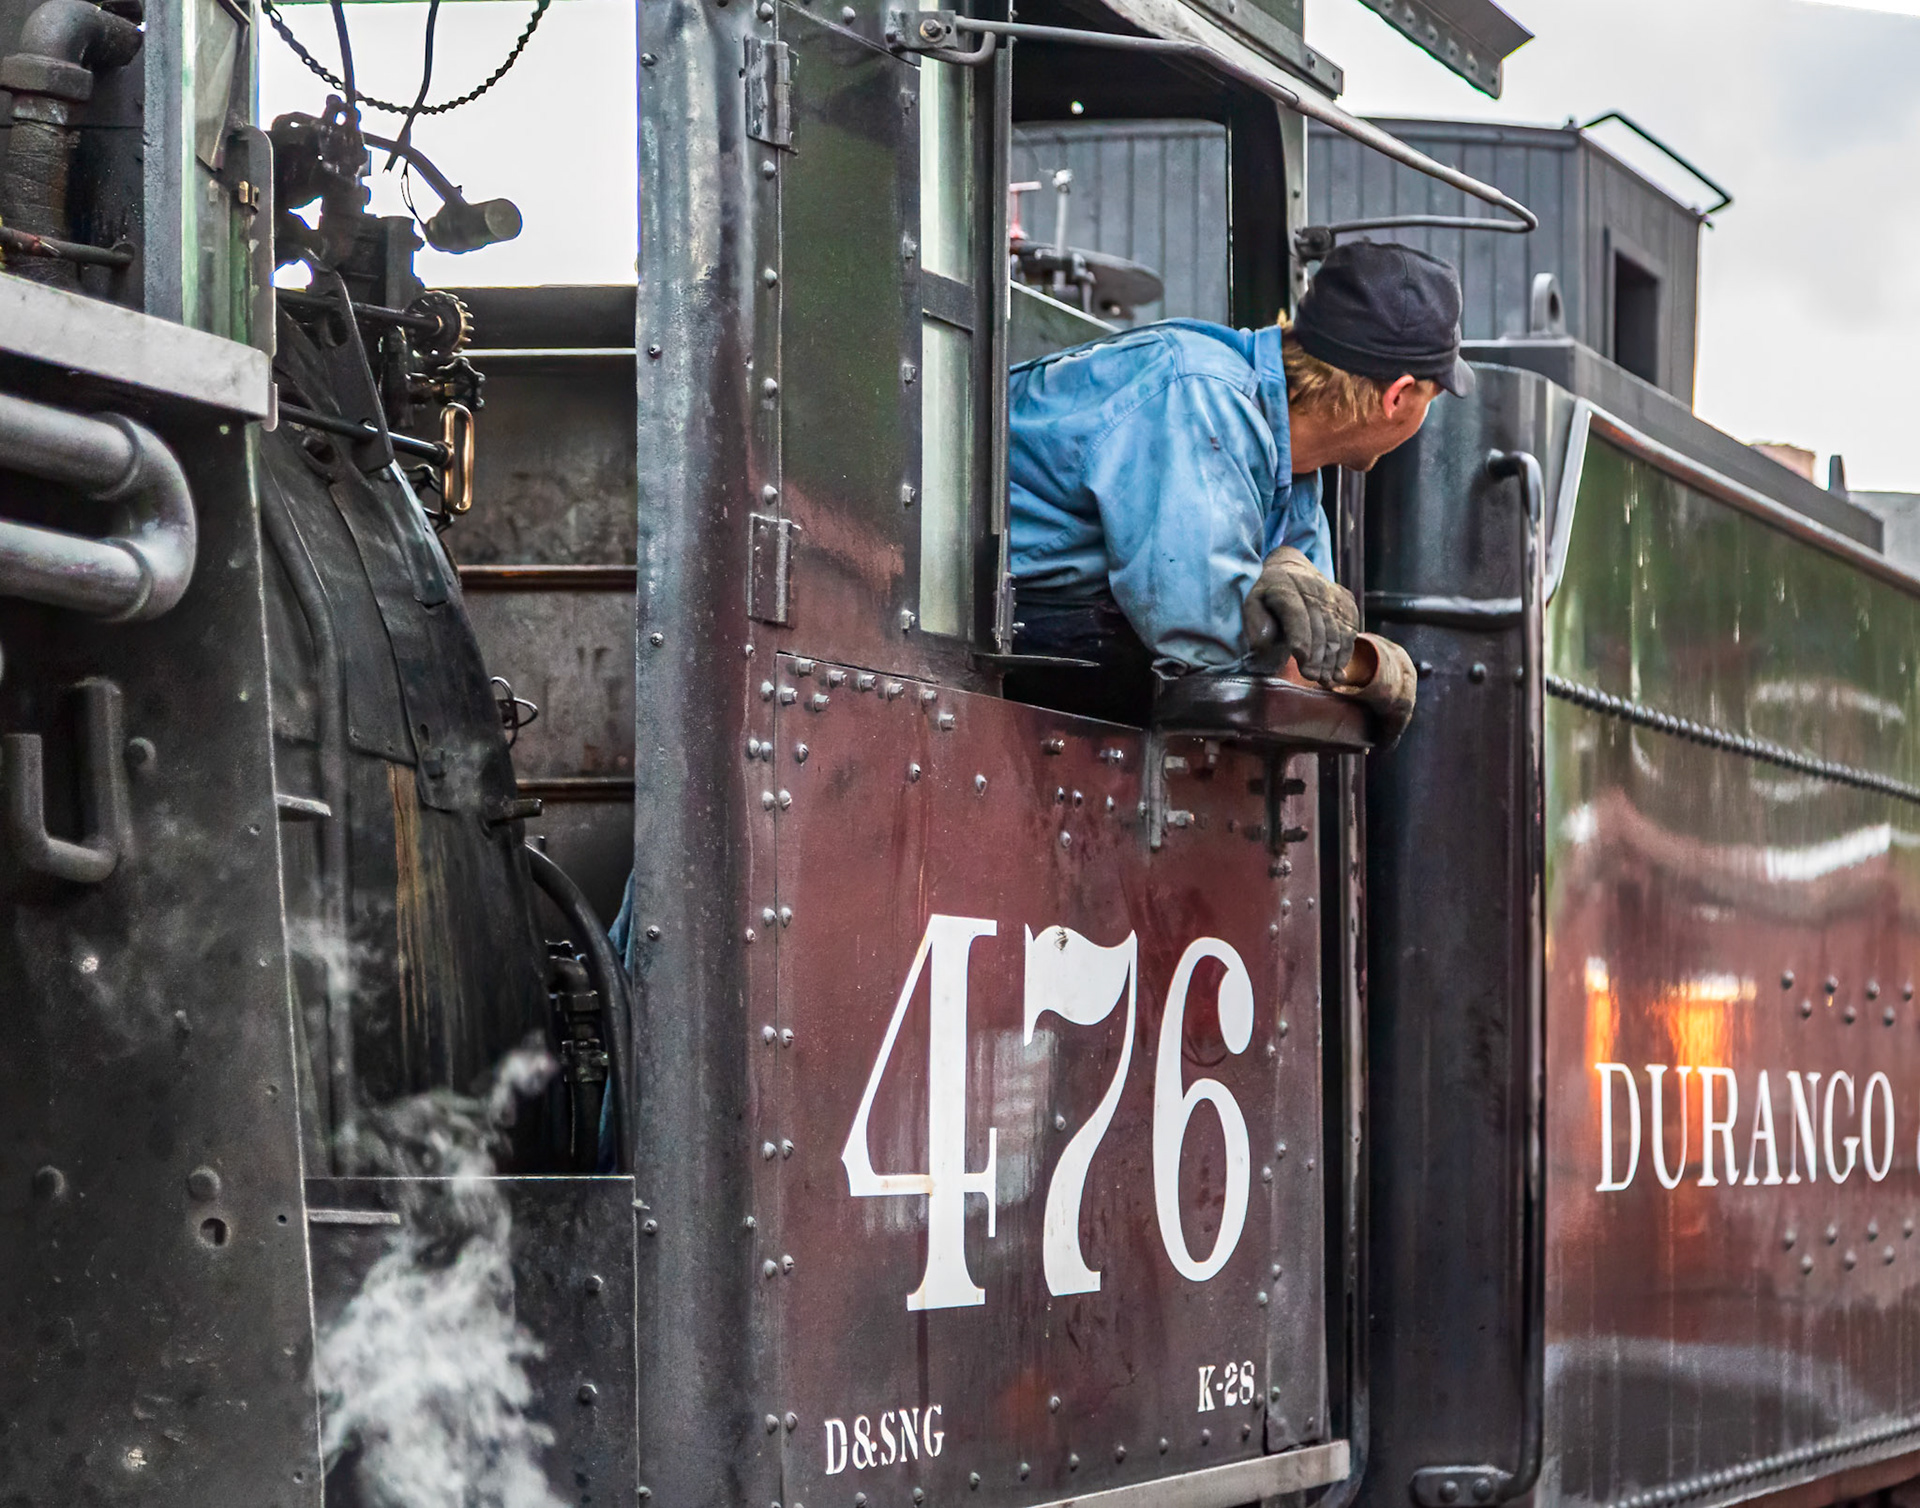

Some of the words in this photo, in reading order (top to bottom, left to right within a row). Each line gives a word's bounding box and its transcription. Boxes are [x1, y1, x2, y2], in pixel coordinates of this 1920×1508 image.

[841, 914, 1254, 1311] 476
[1595, 1063, 1895, 1192] DURANGO
[1197, 1360, 1255, 1412] K-28
[824, 1404, 945, 1475] D&SNG
